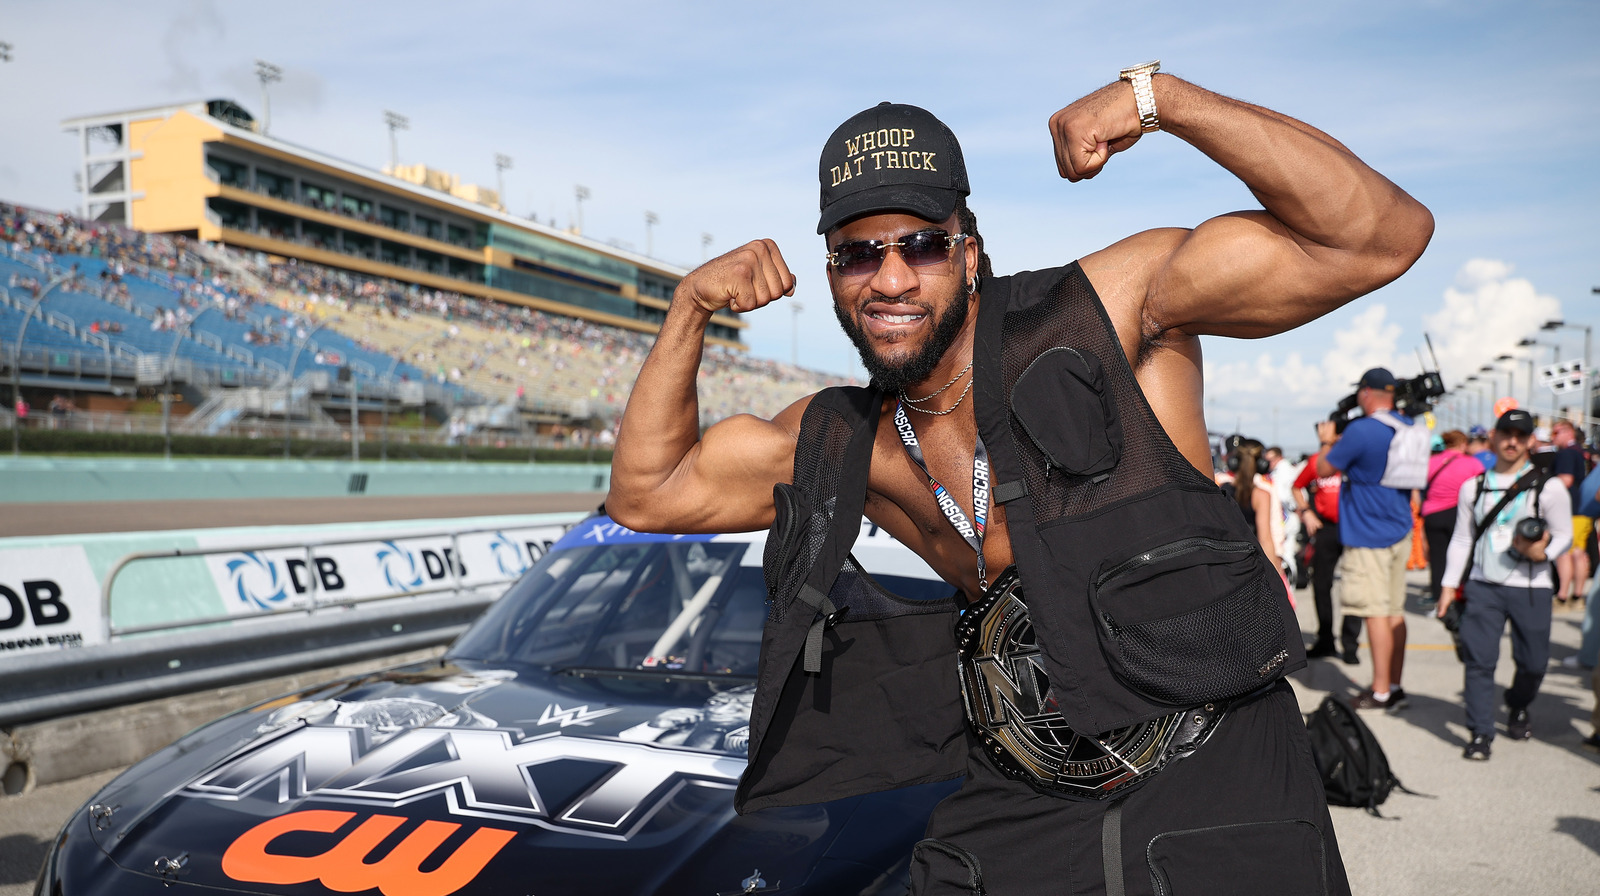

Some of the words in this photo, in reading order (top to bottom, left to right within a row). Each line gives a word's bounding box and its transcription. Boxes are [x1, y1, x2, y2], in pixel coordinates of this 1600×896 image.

[845, 128, 915, 158] WHOOP
[830, 156, 865, 187] DAT
[871, 151, 937, 172] TRICK
[973, 459, 989, 519] NASCAR
[936, 490, 975, 538] NASCAR
[286, 557, 345, 594] DB
[188, 724, 748, 842] NXT
[1063, 755, 1118, 776] CHAMPION
